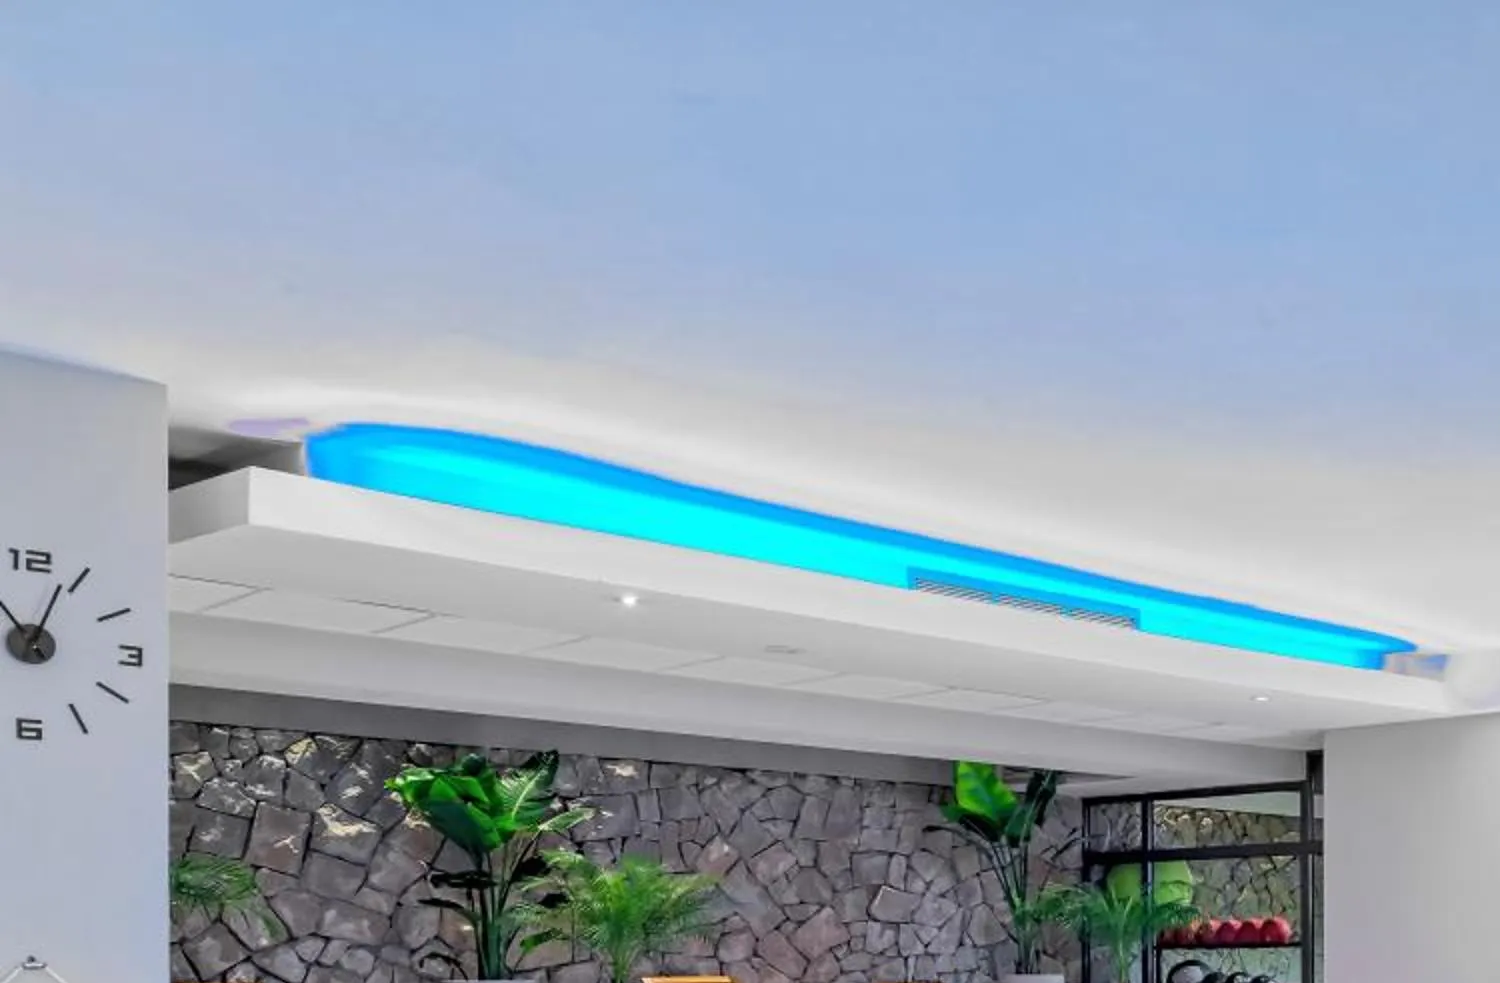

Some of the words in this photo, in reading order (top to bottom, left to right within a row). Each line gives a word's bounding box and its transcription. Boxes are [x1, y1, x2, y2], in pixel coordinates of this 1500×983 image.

[8, 548, 52, 574] 12
[117, 644, 143, 667] 3
[16, 717, 43, 741] 6
